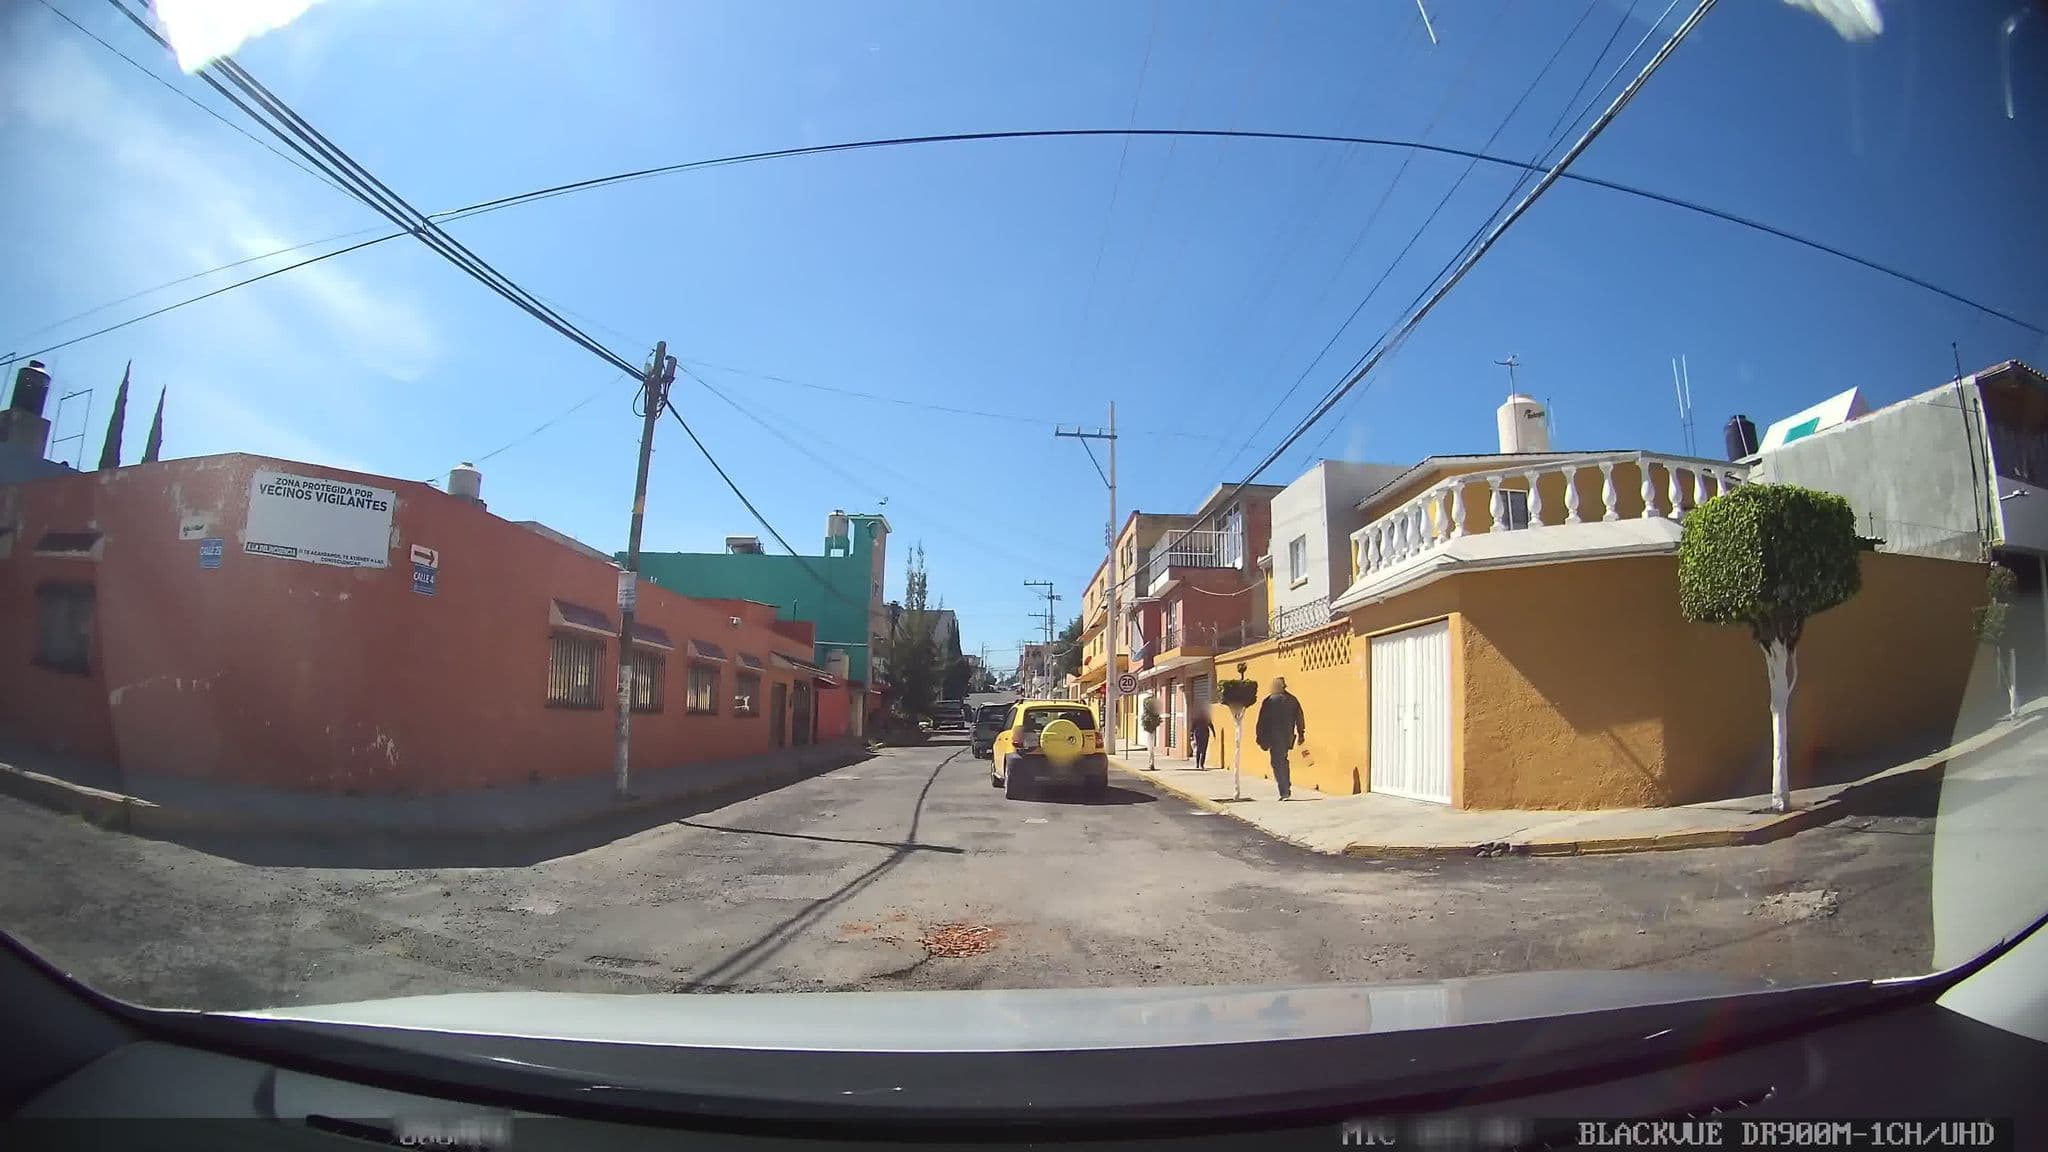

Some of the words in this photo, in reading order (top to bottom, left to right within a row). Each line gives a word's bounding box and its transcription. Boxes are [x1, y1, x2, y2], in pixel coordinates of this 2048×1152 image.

[276, 477, 300, 488] ZONA
[302, 481, 353, 496] PROTEGIDA
[354, 488, 373, 499] POR
[260, 483, 312, 501] VECINOS
[315, 491, 389, 512] VIGILANTES
[413, 571, 429, 584] CALLE
[1121, 678, 1134, 687] 20
